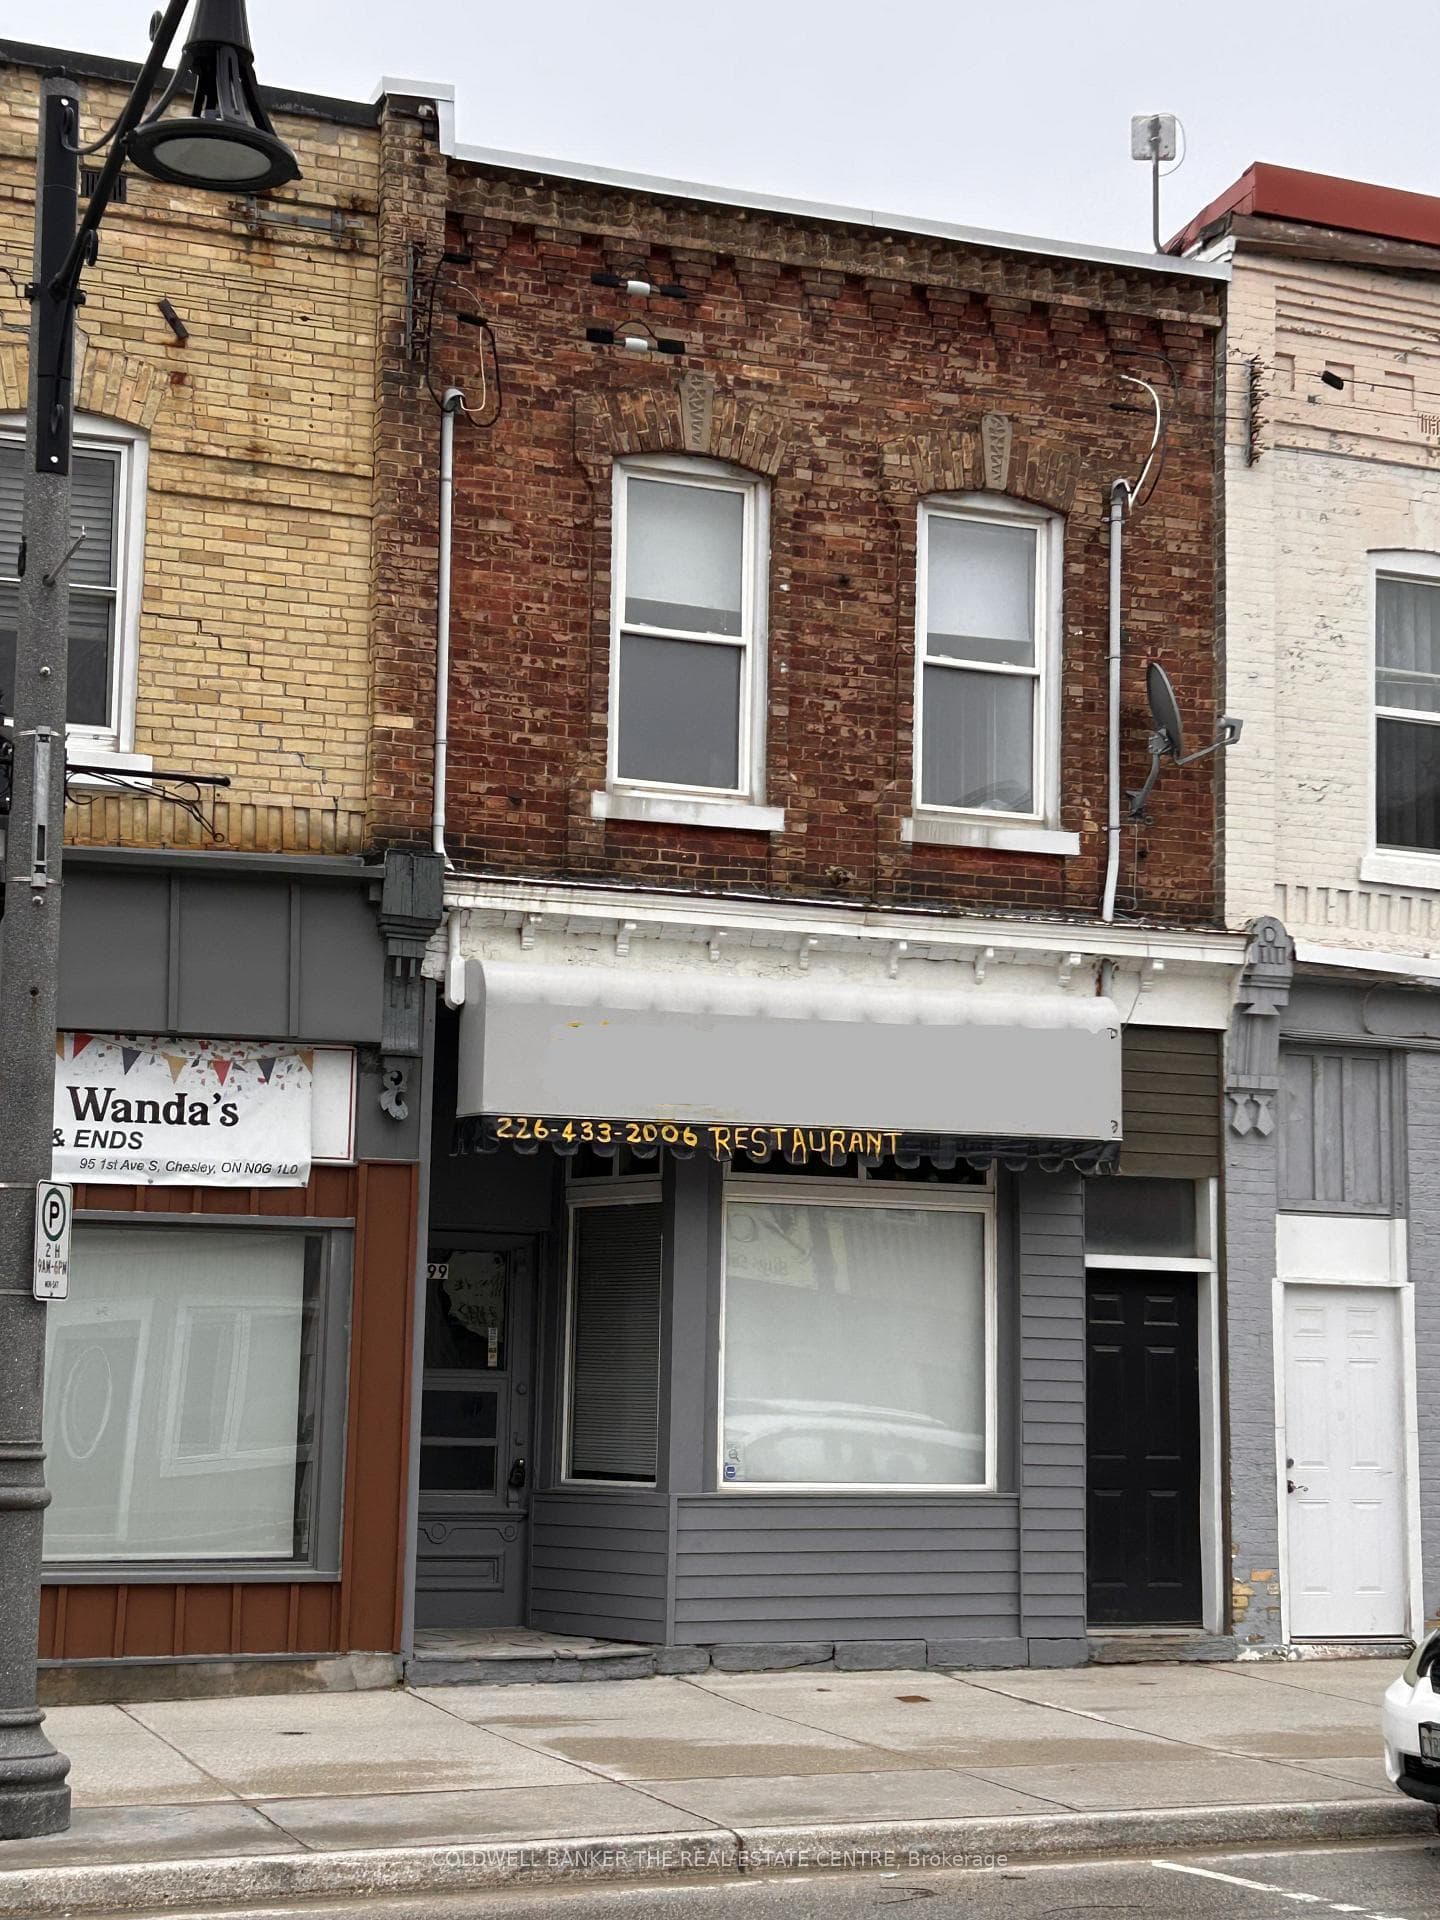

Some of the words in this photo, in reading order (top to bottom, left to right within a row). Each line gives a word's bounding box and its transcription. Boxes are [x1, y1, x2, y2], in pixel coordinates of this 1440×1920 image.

[66, 1086, 239, 1127] Wanda's
[51, 1128, 65, 1147] &
[73, 1128, 144, 1150] ENDS
[496, 1117, 698, 1147] 226-433-2006
[708, 1125, 904, 1165] RESTAURANT
[79, 1157, 96, 1170] 95
[100, 1158, 118, 1171] 1st
[119, 1159, 144, 1171] Ave
[148, 1160, 161, 1173] S,
[165, 1160, 216, 1176] Chesley,
[221, 1161, 242, 1173] ON
[50, 1201, 59, 1228] P
[46, 1243, 51, 1257] 2
[55, 1244, 60, 1258] H
[428, 1265, 447, 1278] 99
